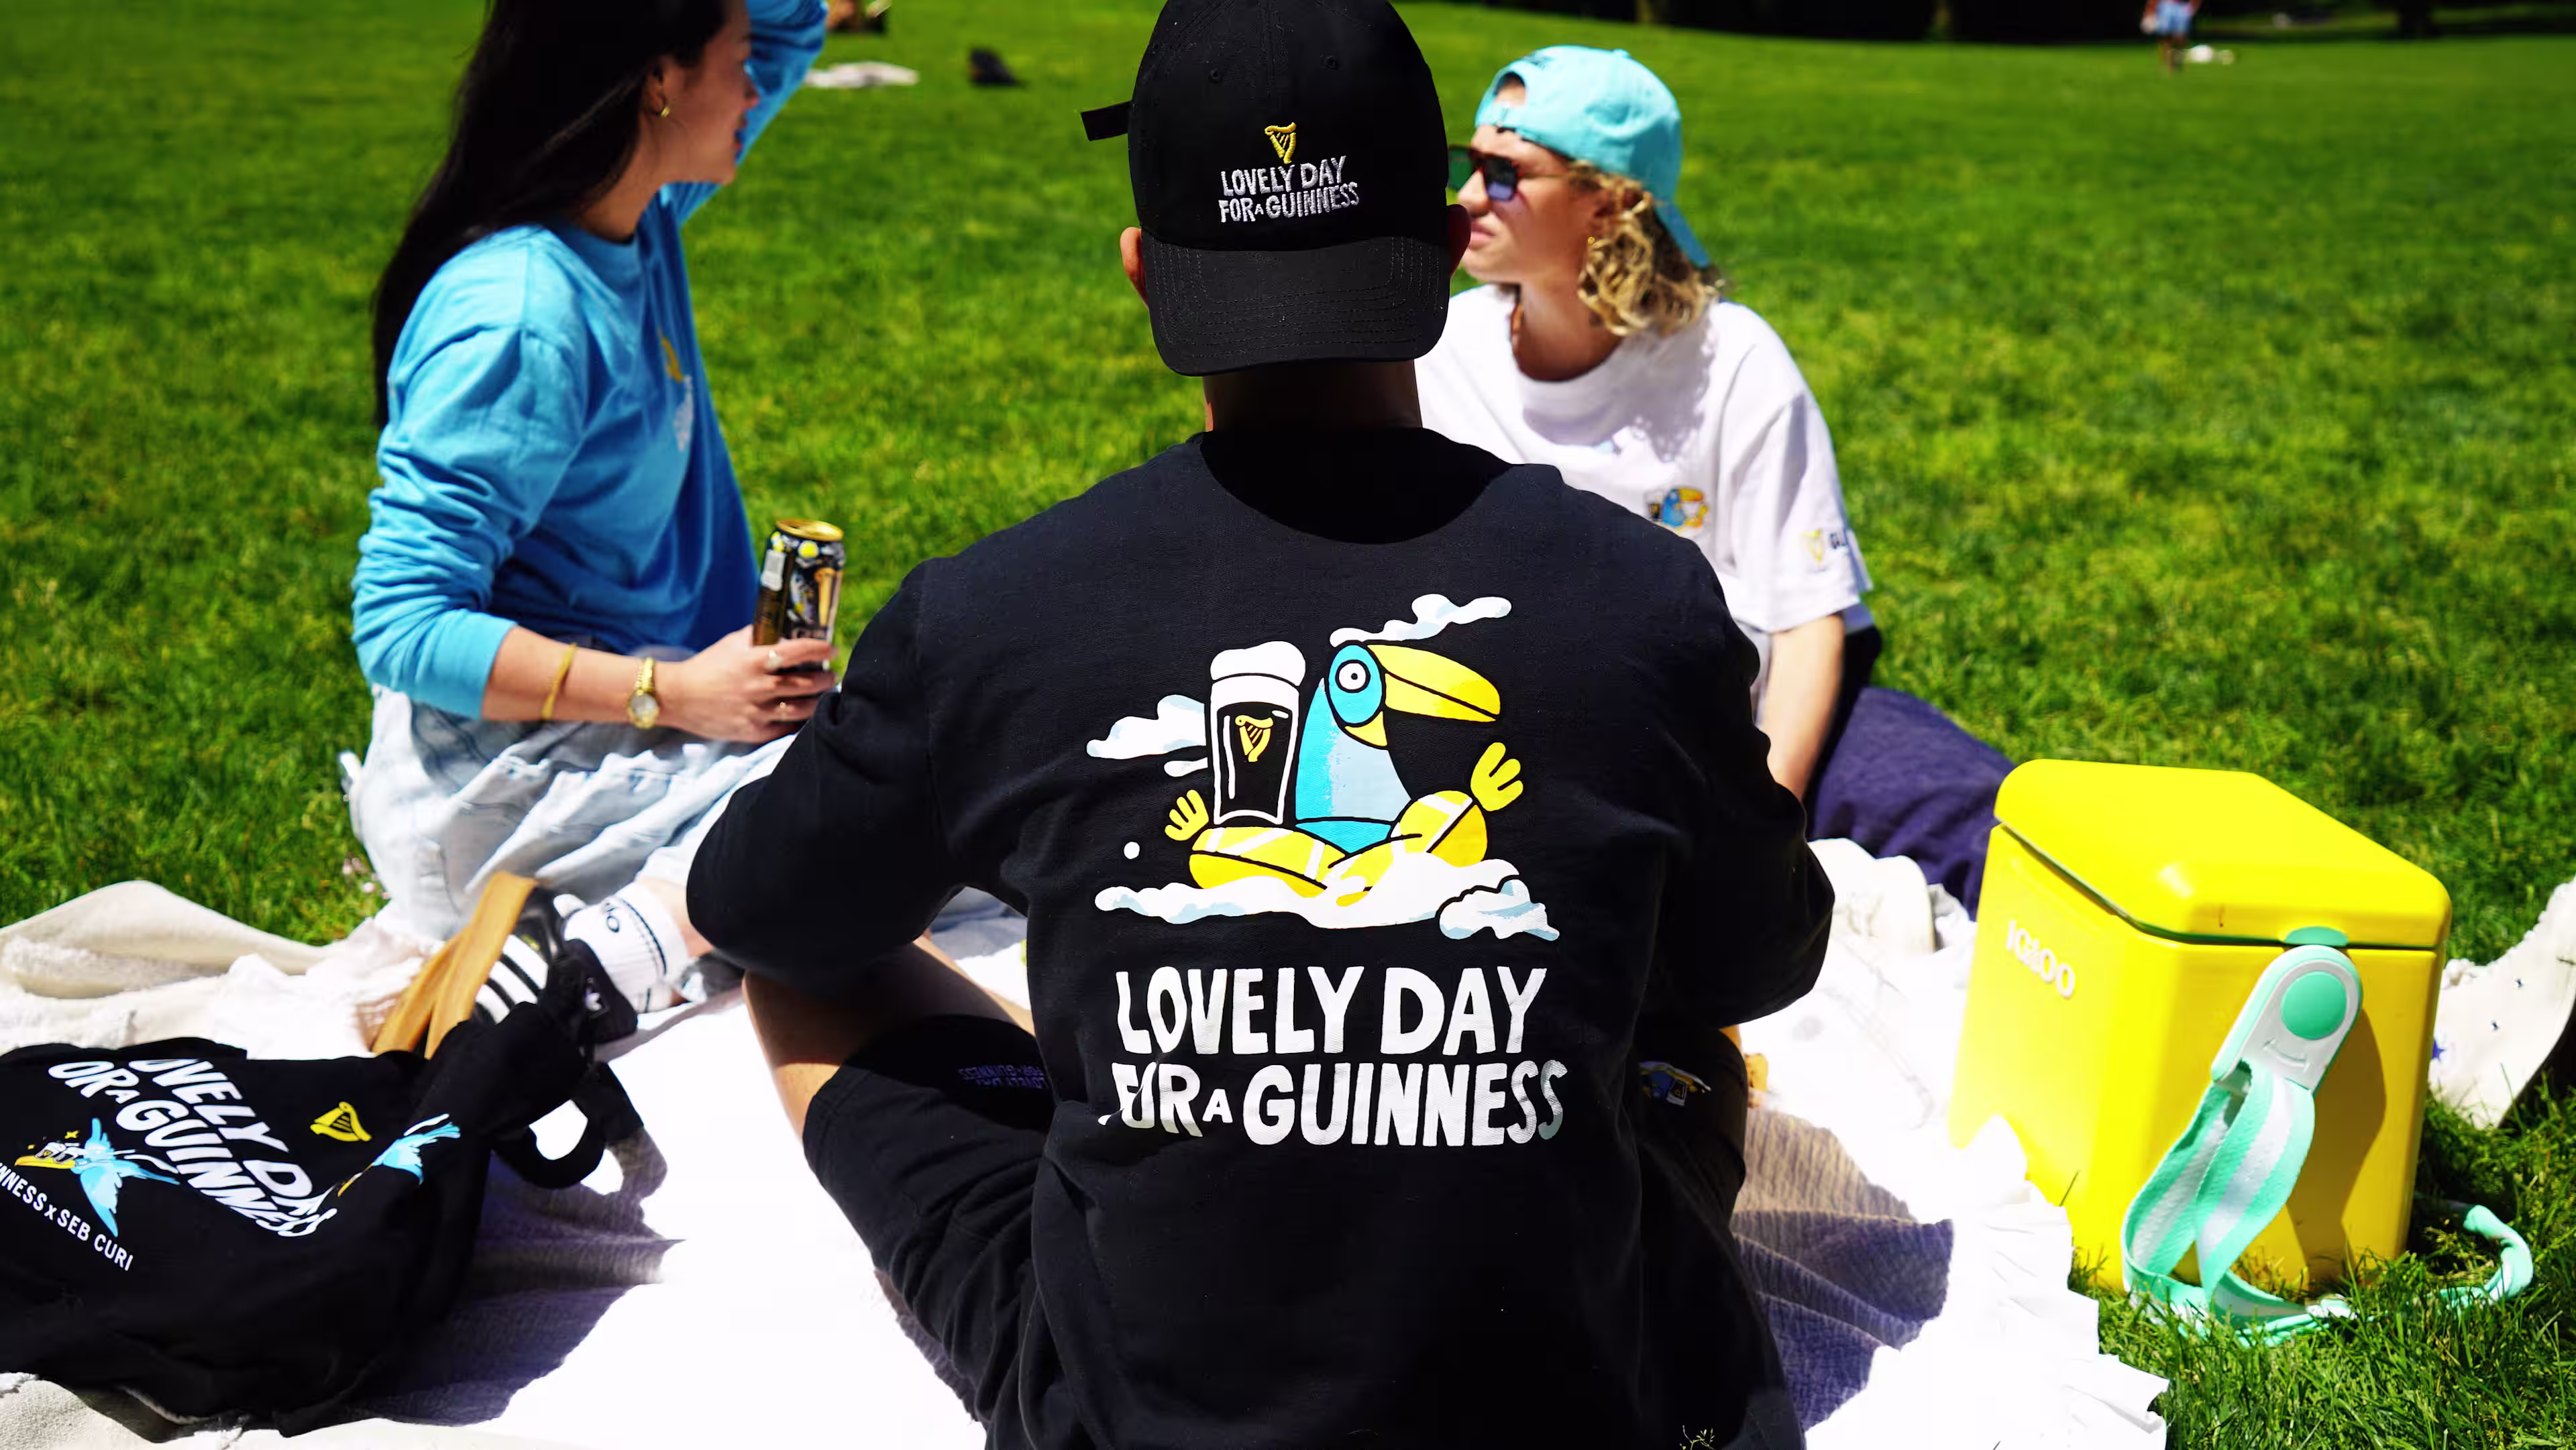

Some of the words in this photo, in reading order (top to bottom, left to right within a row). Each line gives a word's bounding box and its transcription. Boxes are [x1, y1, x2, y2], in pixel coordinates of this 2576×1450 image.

[1218, 198, 1256, 223] FOR
[1254, 203, 1265, 215] A
[1266, 181, 1360, 219] GUINNESS
[1220, 164, 1295, 197] LOVELY
[1300, 155, 1347, 189] DAY
[1115, 966, 1364, 1054] LOVELY
[1380, 967, 1548, 1056] DAY
[105, 1089, 140, 1104] A
[1201, 1088, 1234, 1123] A
[1243, 1059, 1568, 1146] GUINNESS
[116, 1100, 337, 1237] GUINNESS
[57, 1209, 91, 1241] SEB
[93, 1233, 134, 1272] CURI
